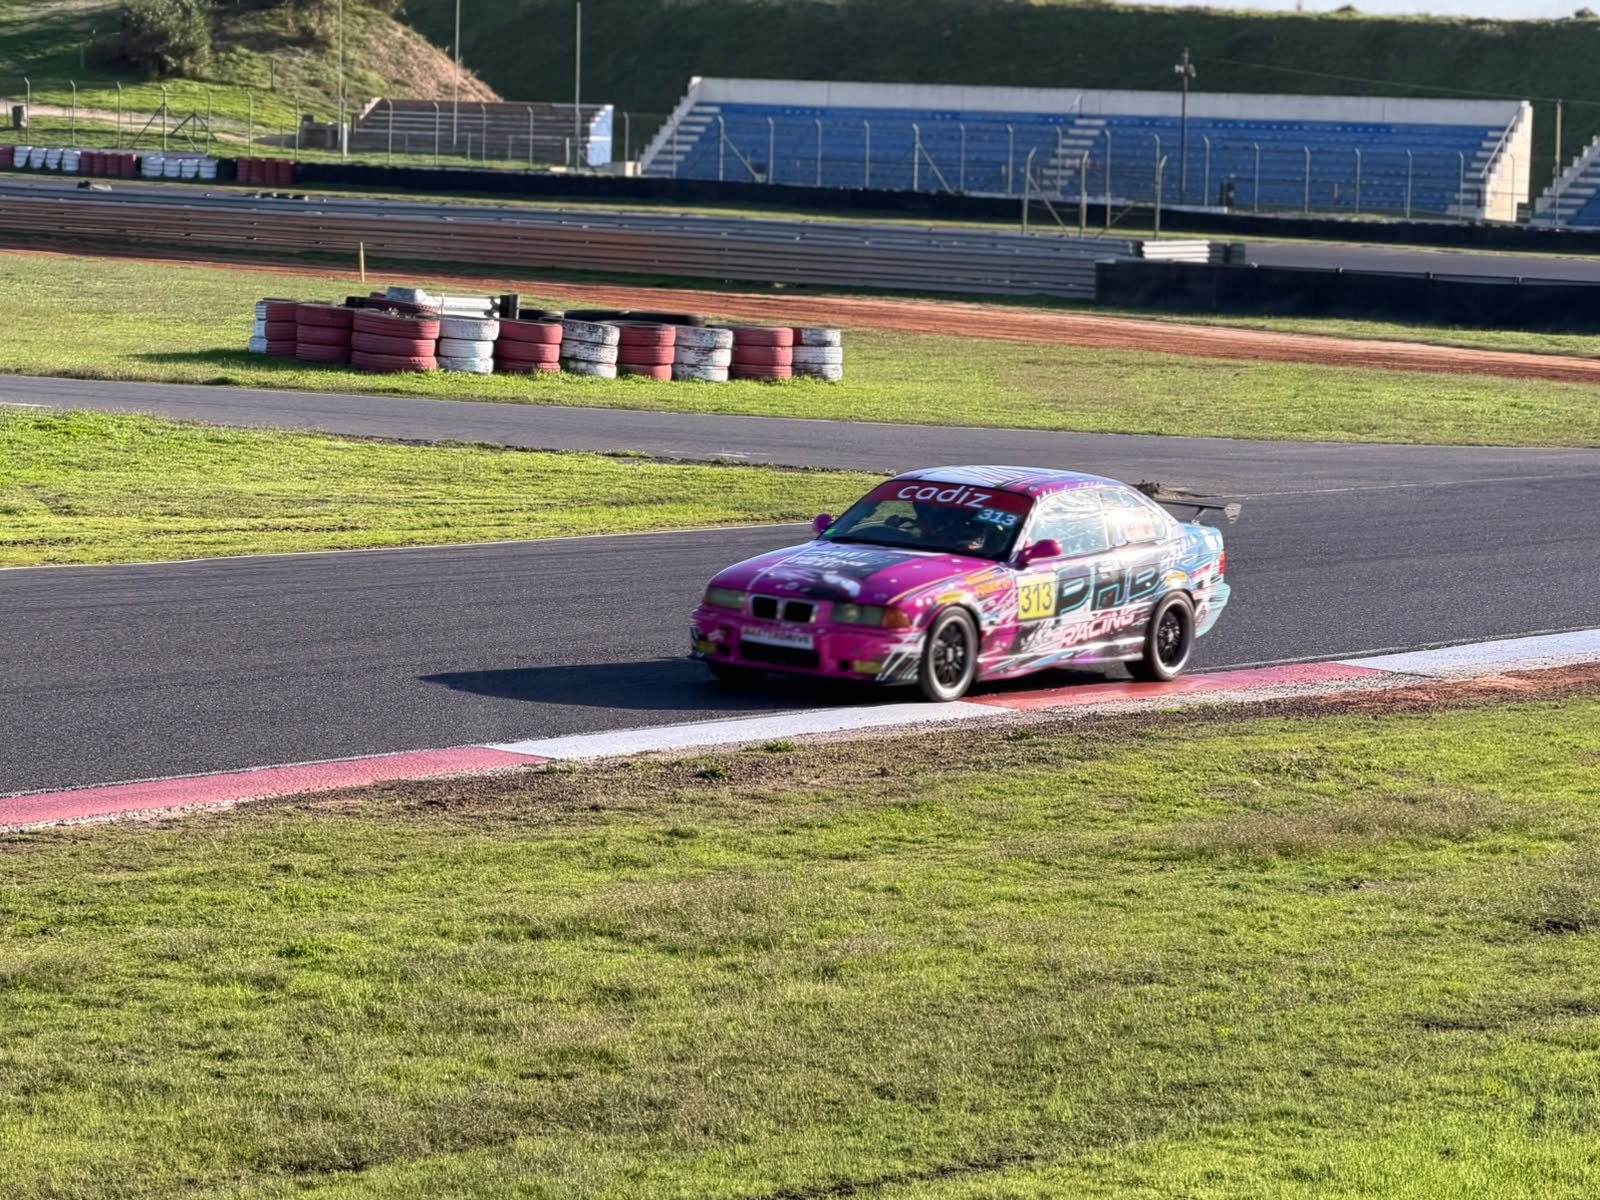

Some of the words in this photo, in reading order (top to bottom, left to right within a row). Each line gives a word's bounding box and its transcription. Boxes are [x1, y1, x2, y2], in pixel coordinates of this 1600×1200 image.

[897, 485, 992, 508] cadiz
[978, 508, 1018, 527] 313
[1020, 581, 1053, 614] 313
[1059, 610, 1137, 647] RACING
